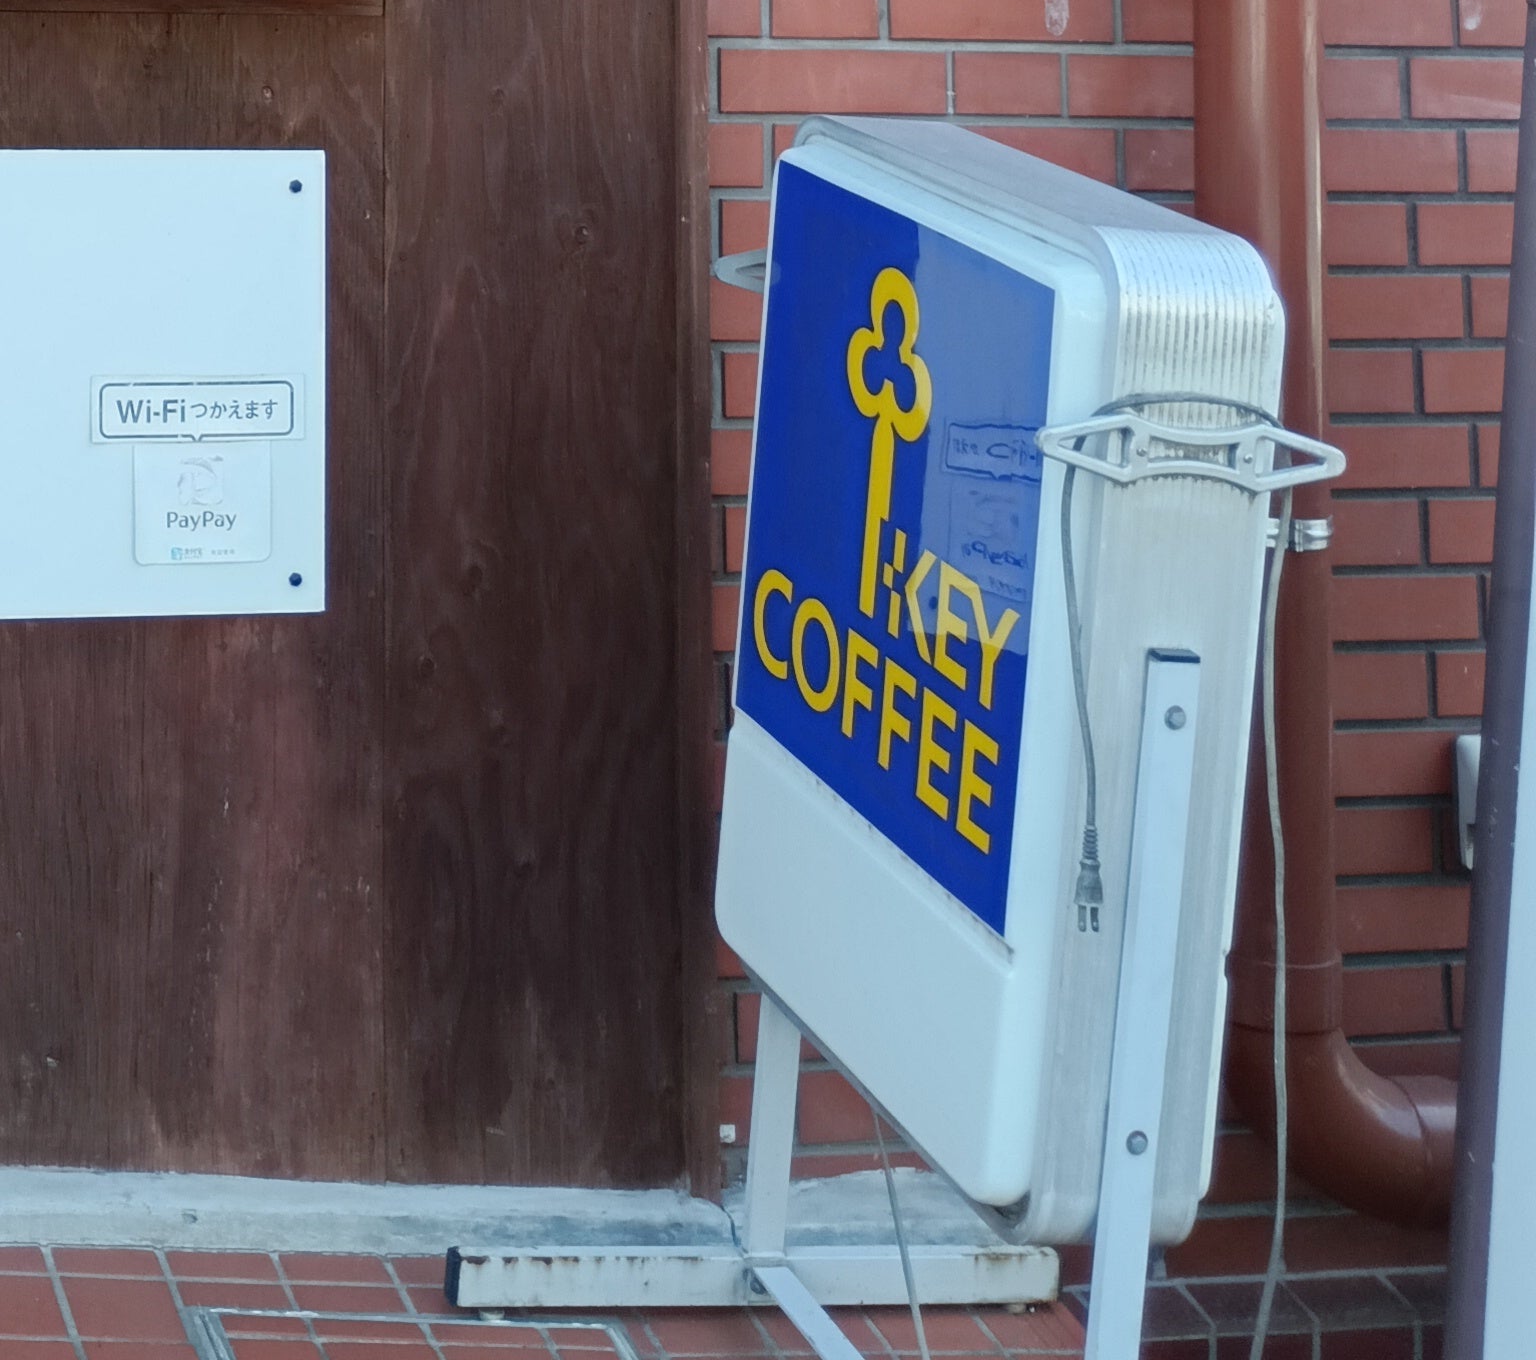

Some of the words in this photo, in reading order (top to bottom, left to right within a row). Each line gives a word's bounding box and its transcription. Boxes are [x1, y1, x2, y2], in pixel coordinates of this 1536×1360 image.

[165, 510, 238, 532] PayPay
[752, 567, 1001, 856] COFFEE
[883, 528, 1022, 713] KEY
